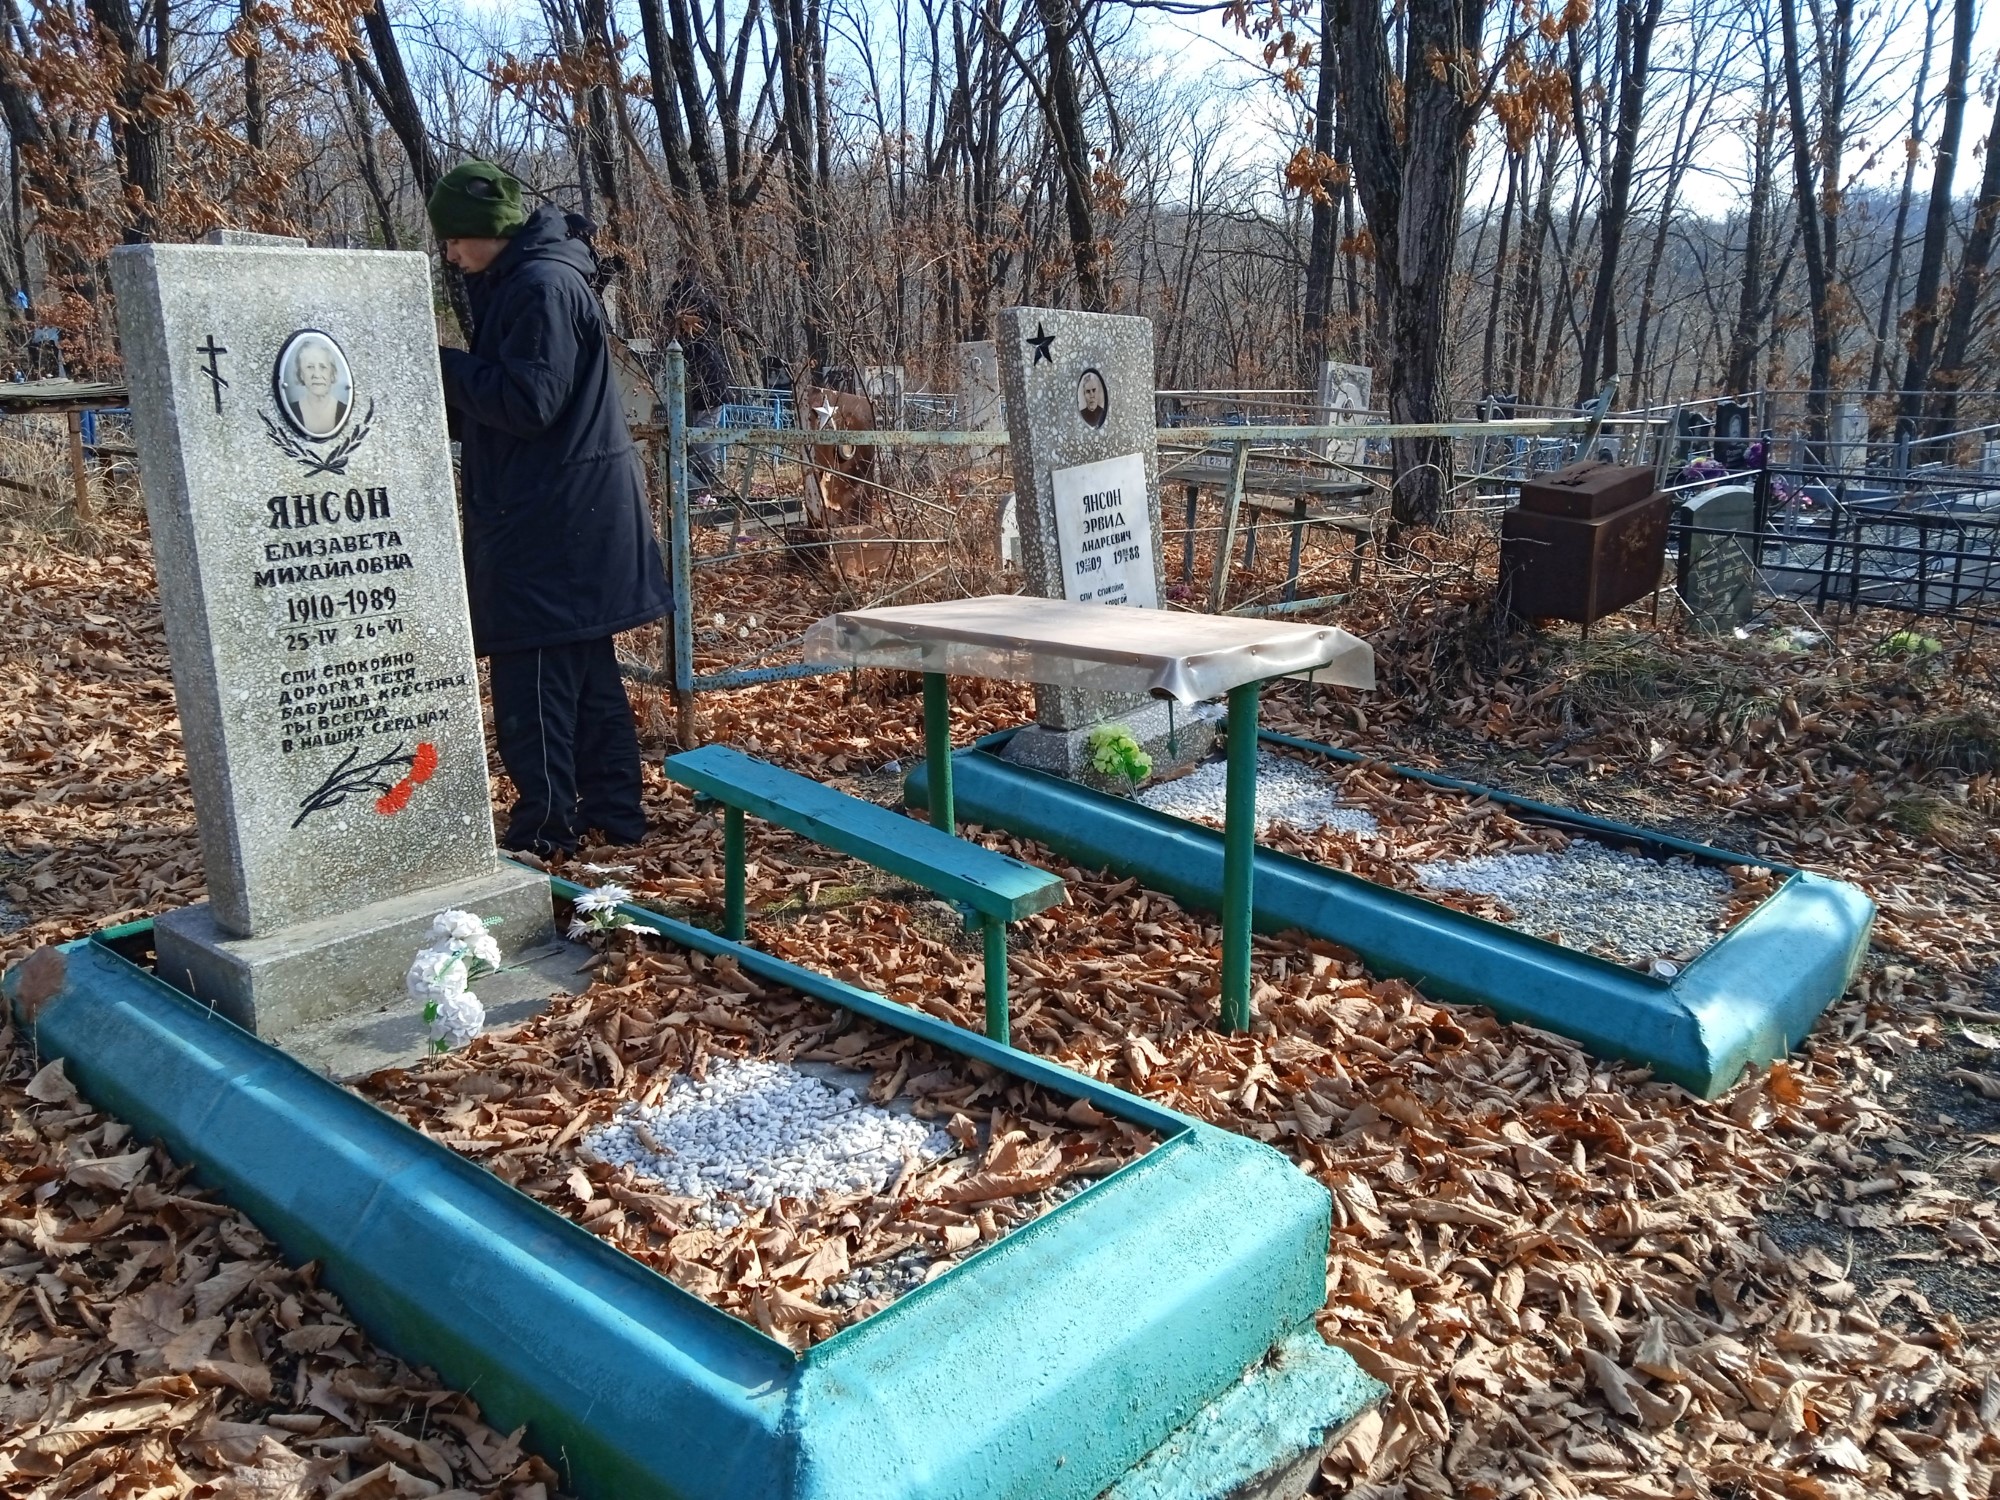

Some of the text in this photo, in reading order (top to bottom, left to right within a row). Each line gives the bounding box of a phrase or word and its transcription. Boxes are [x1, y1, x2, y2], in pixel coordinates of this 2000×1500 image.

[267, 487, 391, 530] ЯНСОН
[1083, 488, 1122, 514] ЯНСОН
[1083, 512, 1125, 535] ЭРВИД
[264, 531, 403, 562] ЕЛИЗАВЕТА
[1082, 530, 1131, 553] АНДРЕЕВИЧ
[254, 553, 413, 588] МИХАЙЛОВНА
[1080, 592, 1093, 602] СПИ
[281, 652, 414, 685] СПИ СПОКОЙНО
[279, 677, 365, 706] ДОРОГАЯ
[281, 694, 369, 720] БАБУШКА
[281, 706, 389, 735] ТЫ ВСЕГДА
[282, 708, 449, 753] В НАШИХ СЕРДЦАХ
